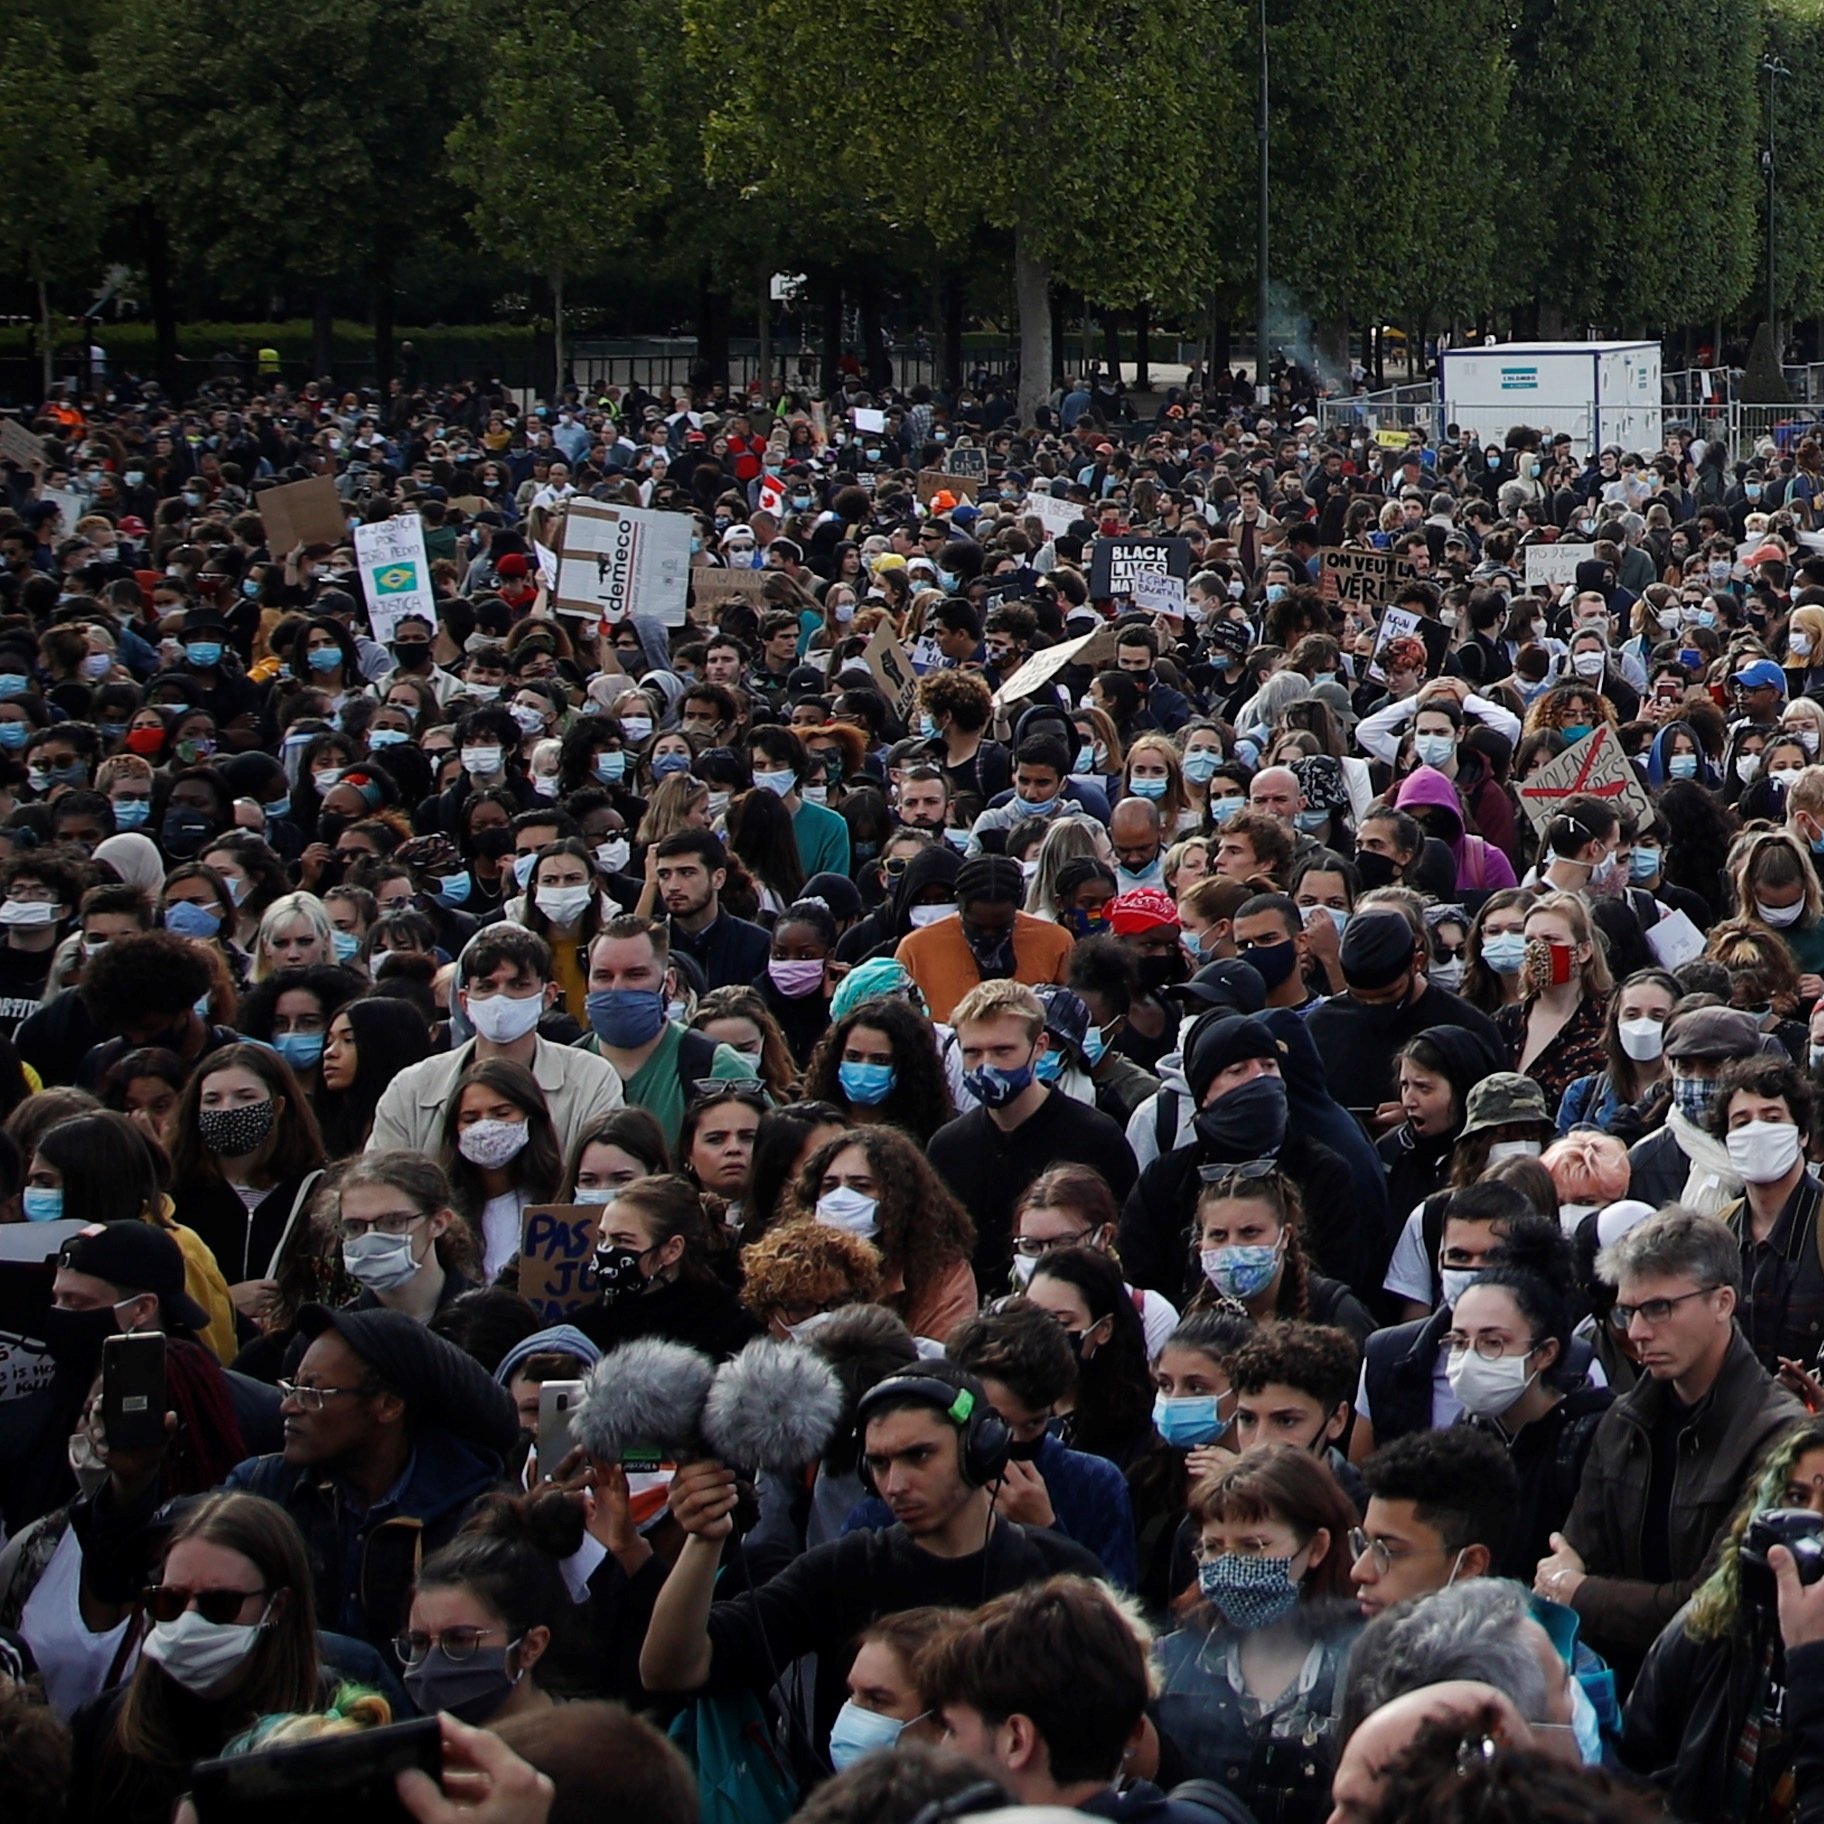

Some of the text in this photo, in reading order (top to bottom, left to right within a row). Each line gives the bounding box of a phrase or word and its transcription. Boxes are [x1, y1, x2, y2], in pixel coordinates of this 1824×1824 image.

[599, 519, 632, 612] demeco
[1111, 545, 1169, 562] BLACK
[1327, 552, 1418, 578] ON VEUT LA
[1110, 579, 1136, 594] MAT
[525, 1213, 593, 1261] PAS
[544, 1260, 599, 1297] JU
